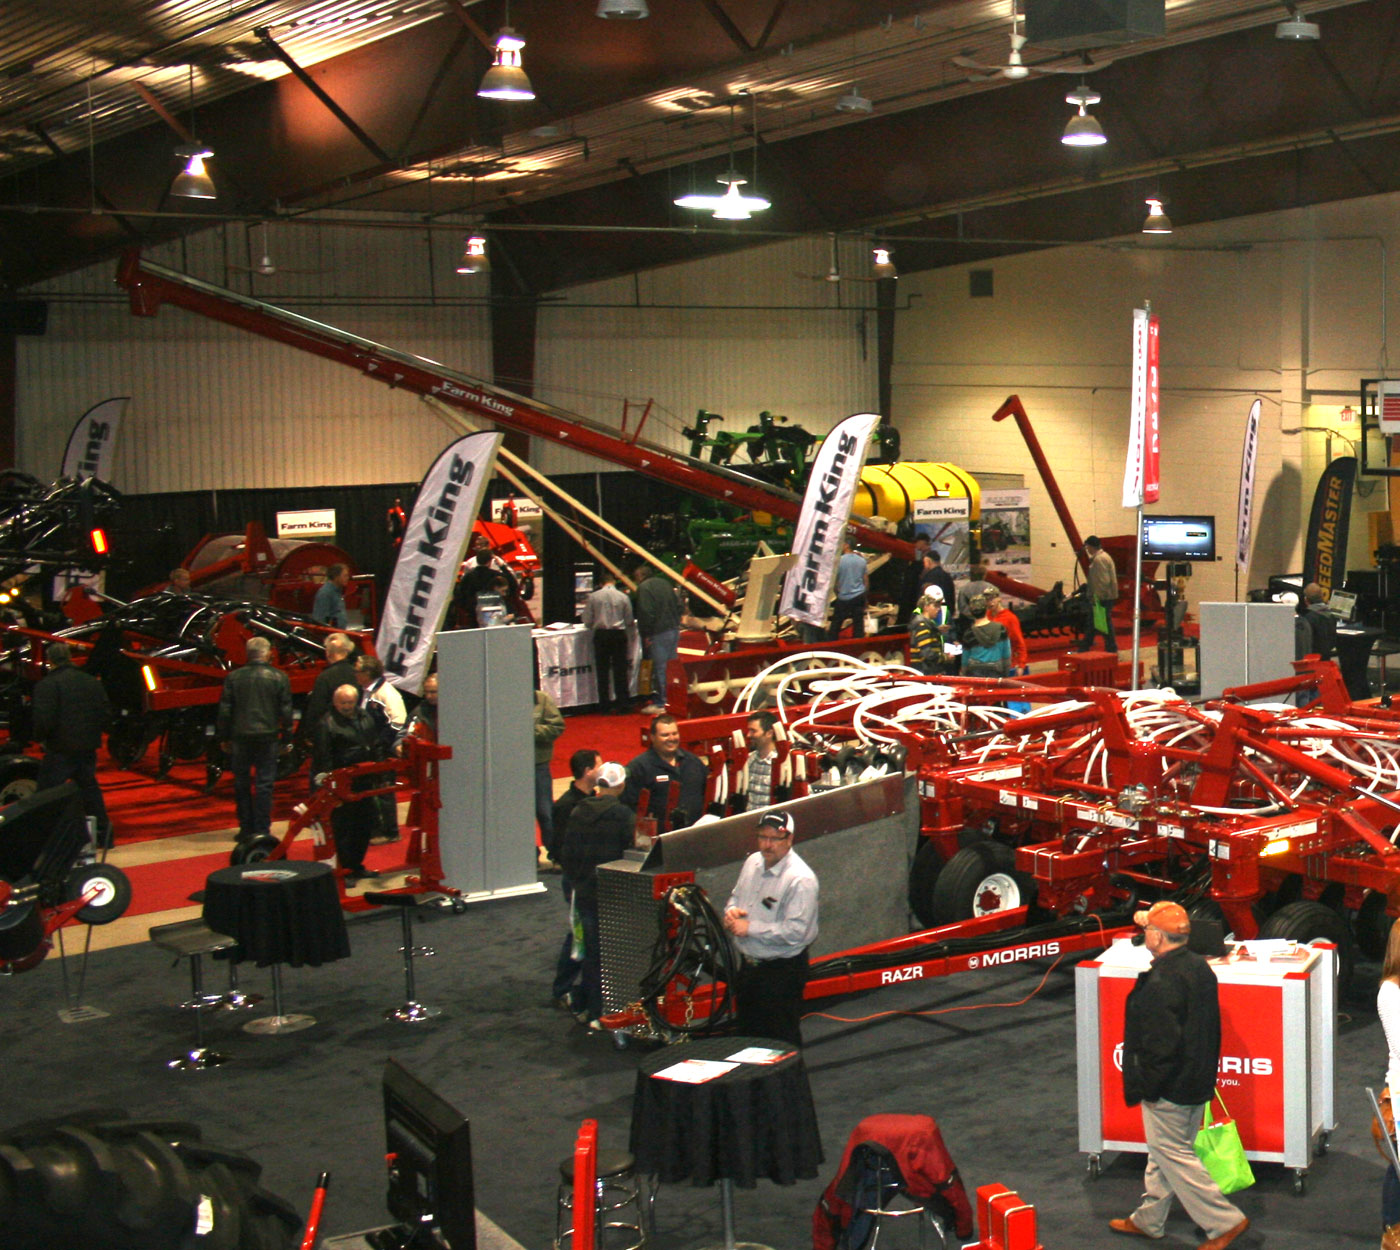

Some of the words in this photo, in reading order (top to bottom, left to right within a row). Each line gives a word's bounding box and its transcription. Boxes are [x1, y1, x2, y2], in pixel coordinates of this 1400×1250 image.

[442, 381, 480, 402] Farm
[481, 395, 515, 417] King
[78, 419, 110, 478] ing
[519, 506, 541, 514] King
[944, 507, 967, 515] King
[309, 521, 333, 529] King
[792, 519, 830, 613] Farm
[814, 430, 858, 515] King
[385, 564, 437, 678] Farm
[418, 453, 475, 560] King
[547, 664, 593, 678] Farm
[983, 942, 1060, 967] MORRIS
[882, 965, 924, 984] RAZR
[1217, 1056, 1273, 1075] RIS
[1221, 1079, 1241, 1088] you.
